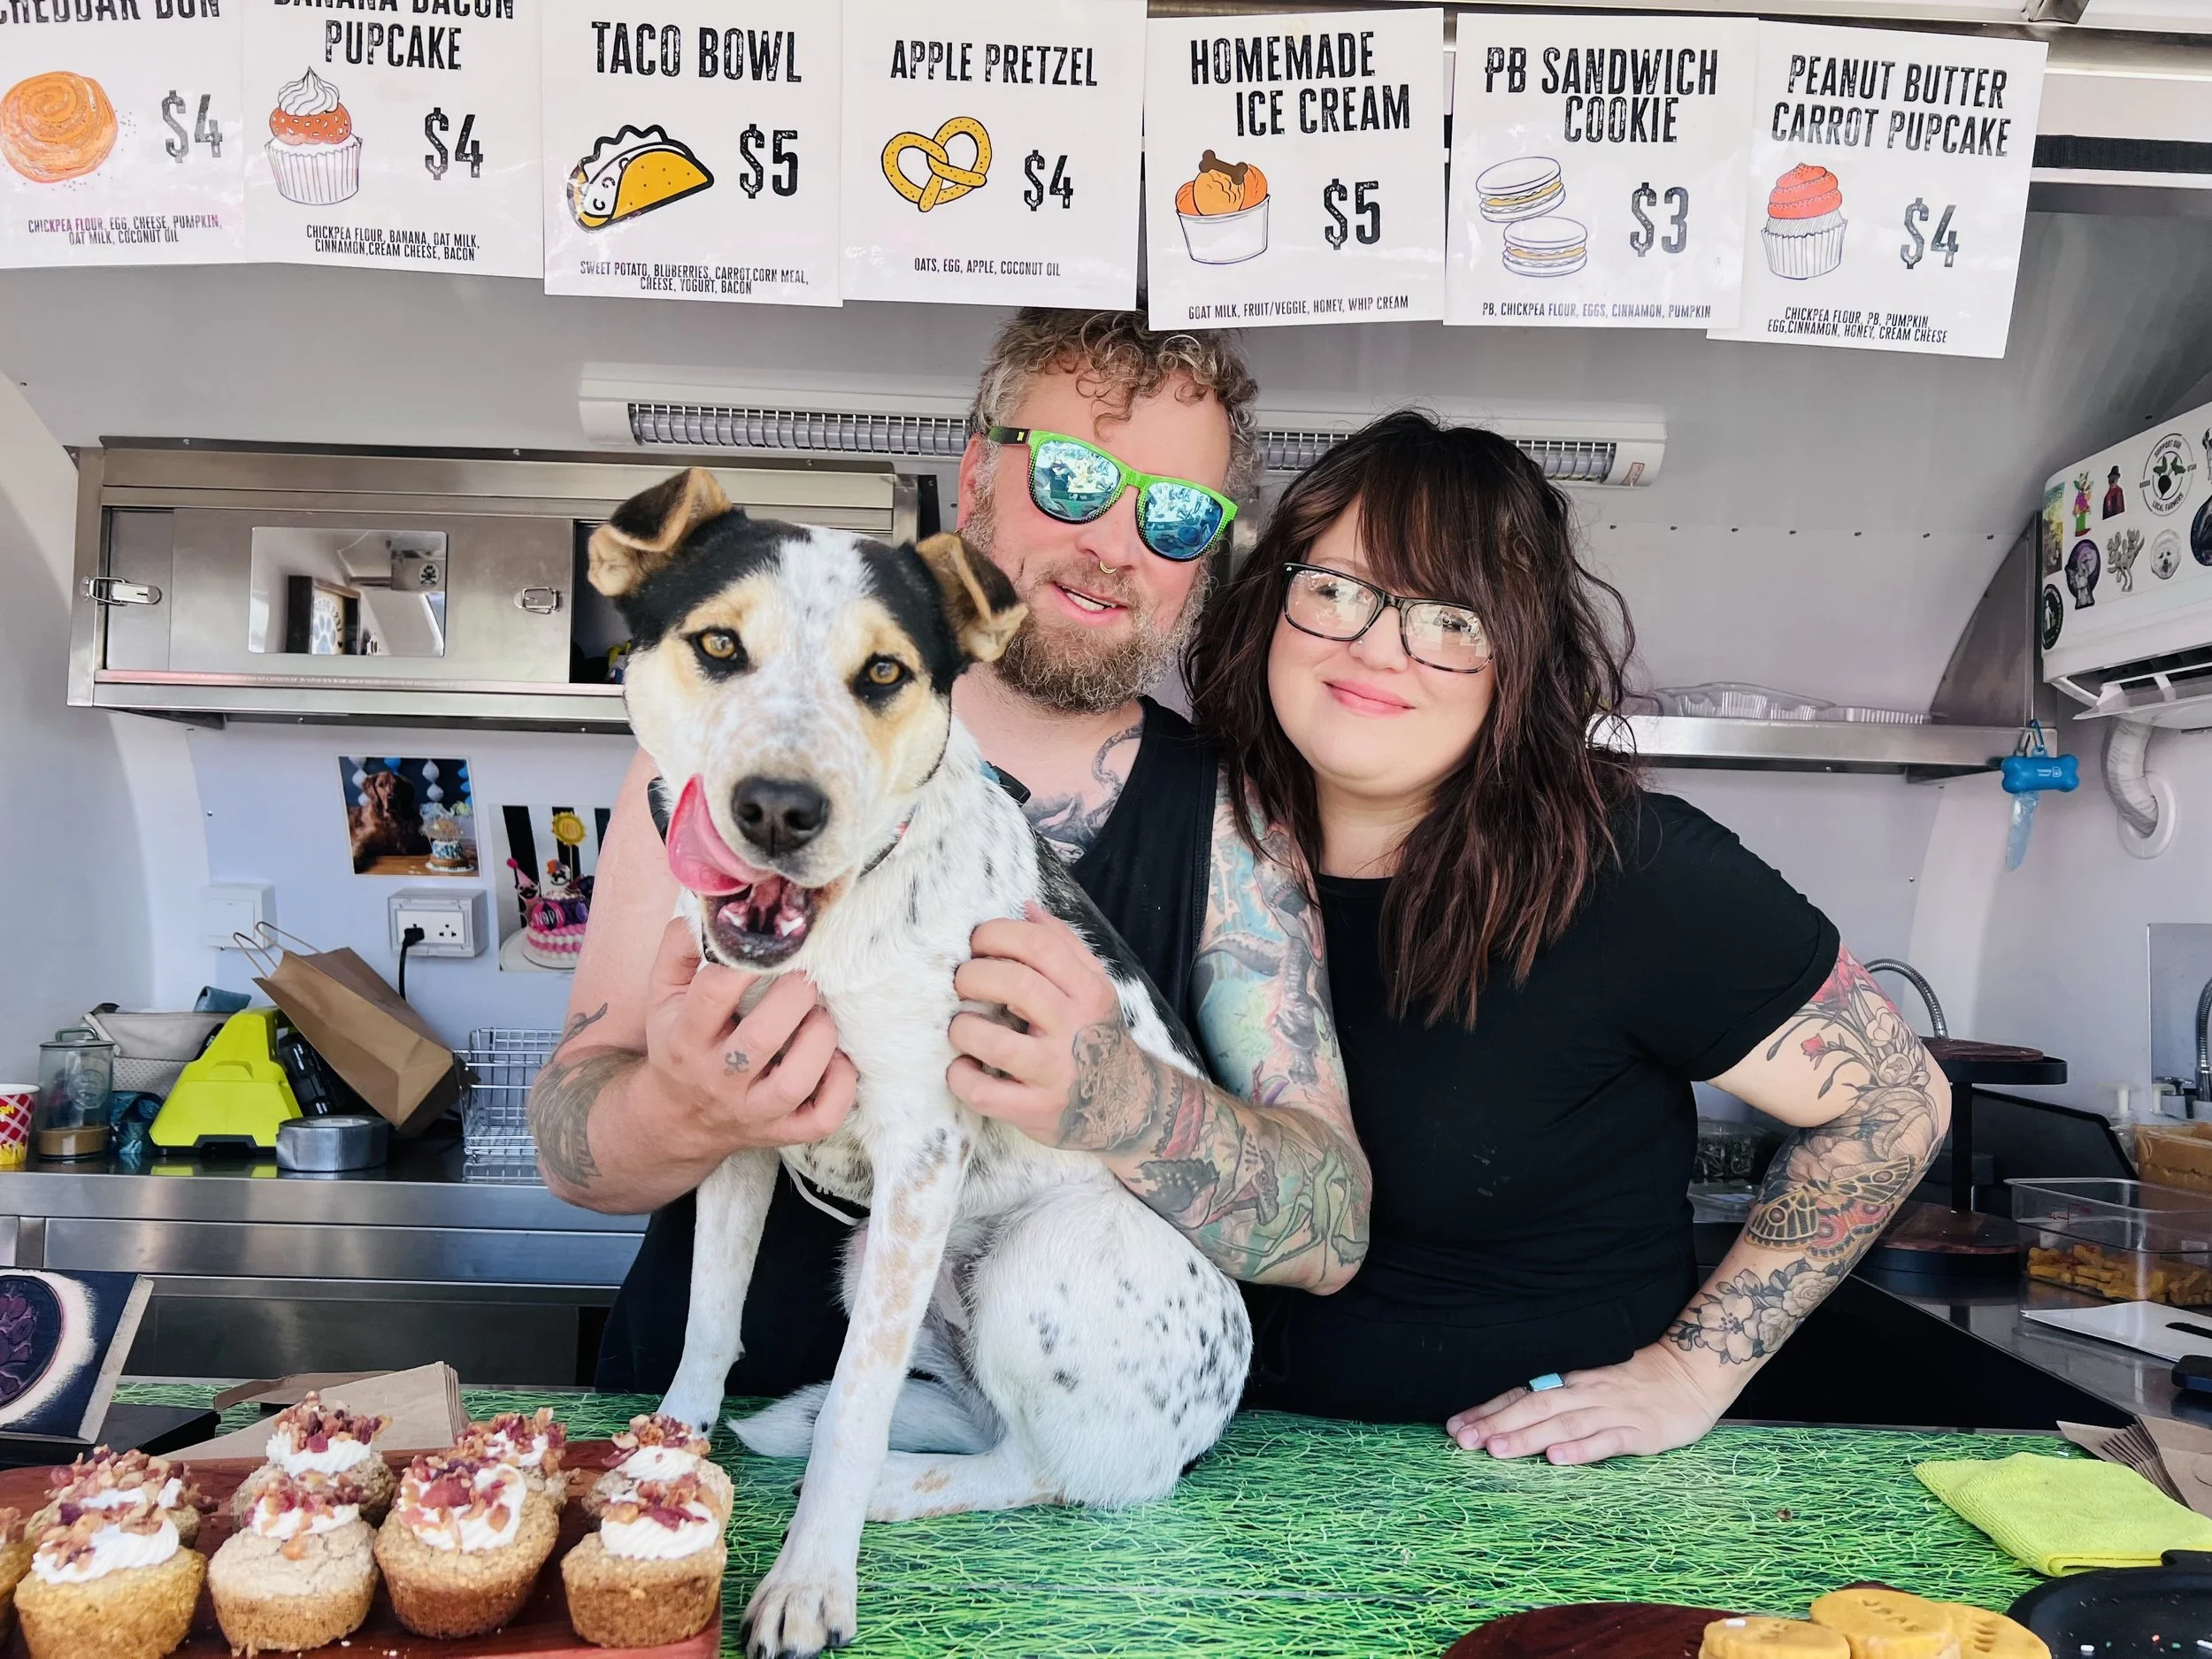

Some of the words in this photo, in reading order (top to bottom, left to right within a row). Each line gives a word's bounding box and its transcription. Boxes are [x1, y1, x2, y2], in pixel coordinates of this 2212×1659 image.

[326, 19, 462, 71] PUPCAKE
[591, 21, 680, 77] TACO
[698, 27, 803, 83] BOWL
[891, 40, 972, 81] APPLE
[985, 44, 1097, 87] PRETZEL
[1190, 31, 1375, 85] HOMEMADE
[1485, 47, 1526, 93] PB
[1541, 47, 1718, 95] SANDWICH
[1787, 54, 1895, 100] PEANUT
[1903, 63, 2008, 109] BUTTER
[161, 90, 223, 164] $4
[1236, 90, 1285, 137] ICE
[1299, 84, 1409, 134] CREAM
[1564, 96, 1678, 142] COOKIE
[1771, 102, 1878, 148] CARROT
[1887, 110, 2011, 157] PUPCAKE
[425, 107, 484, 180] $4
[740, 124, 798, 199] $5
[1024, 150, 1073, 212] $4
[28, 219, 73, 233] CHICKPEA
[75, 217, 107, 232] FLOUR,
[110, 217, 130, 231] EGG,
[134, 216, 169, 231] CHEESE,
[173, 214, 222, 229] PUMPKIN,
[69, 231, 85, 245] OAT
[89, 231, 115, 245] MILK,
[119, 229, 160, 243] COCONUT
[165, 229, 179, 243] OIL
[306, 225, 351, 240] CHICKPEA
[355, 227, 386, 243] FLOUR,
[389, 230, 430, 246] BANANA,
[434, 233, 450, 246] OAT
[454, 234, 480, 249] MILK,
[1324, 178, 1380, 250] $5
[1630, 181, 1688, 257] $3
[1901, 197, 1958, 270] $4
[404, 244, 441, 260] CHEESE,
[444, 247, 475, 261] BACON
[580, 260, 611, 275] SWEET
[614, 263, 650, 278] POTATO,
[654, 265, 711, 280] BLUBERRIES,
[780, 269, 809, 285] MEAL,
[914, 257, 940, 273] OATS,
[943, 258, 963, 273] EGG,
[966, 259, 997, 274] APPLE,
[1001, 261, 1043, 275] COCONUT
[1047, 263, 1060, 276] OIL
[641, 277, 677, 292] CHEESE,
[680, 278, 718, 294] YOGURT,
[721, 280, 752, 295] BACON
[1188, 305, 1211, 319] GOAT
[1215, 303, 1240, 319] MILK,
[1243, 300, 1310, 318] FRUIT/VEGGIE,
[1313, 298, 1345, 314] HONEY,
[1348, 297, 1373, 311] WHIP
[1377, 295, 1409, 310] CREAM
[1482, 303, 1497, 317] PB,
[1501, 303, 1545, 317] CHICKPEA
[1548, 303, 1579, 319] FLOUR,
[1583, 303, 1609, 319] EGGS,
[1612, 303, 1665, 319] CINNAMON,
[1669, 304, 1711, 319] PUMPKIN
[1785, 307, 1829, 322] CHICKPEA
[1832, 310, 1863, 325] FLOUR,
[1867, 312, 1882, 326] PB,
[1886, 313, 1931, 330] PUMPKIN,
[1844, 324, 1875, 340] HONEY,
[1879, 326, 1911, 342] CREAM
[1915, 328, 1947, 343] CHEESE
[2154, 440, 2174, 457] SUPPORT
[2153, 500, 2164, 511] LOCAL
[2165, 492, 2184, 511] FARMERS
